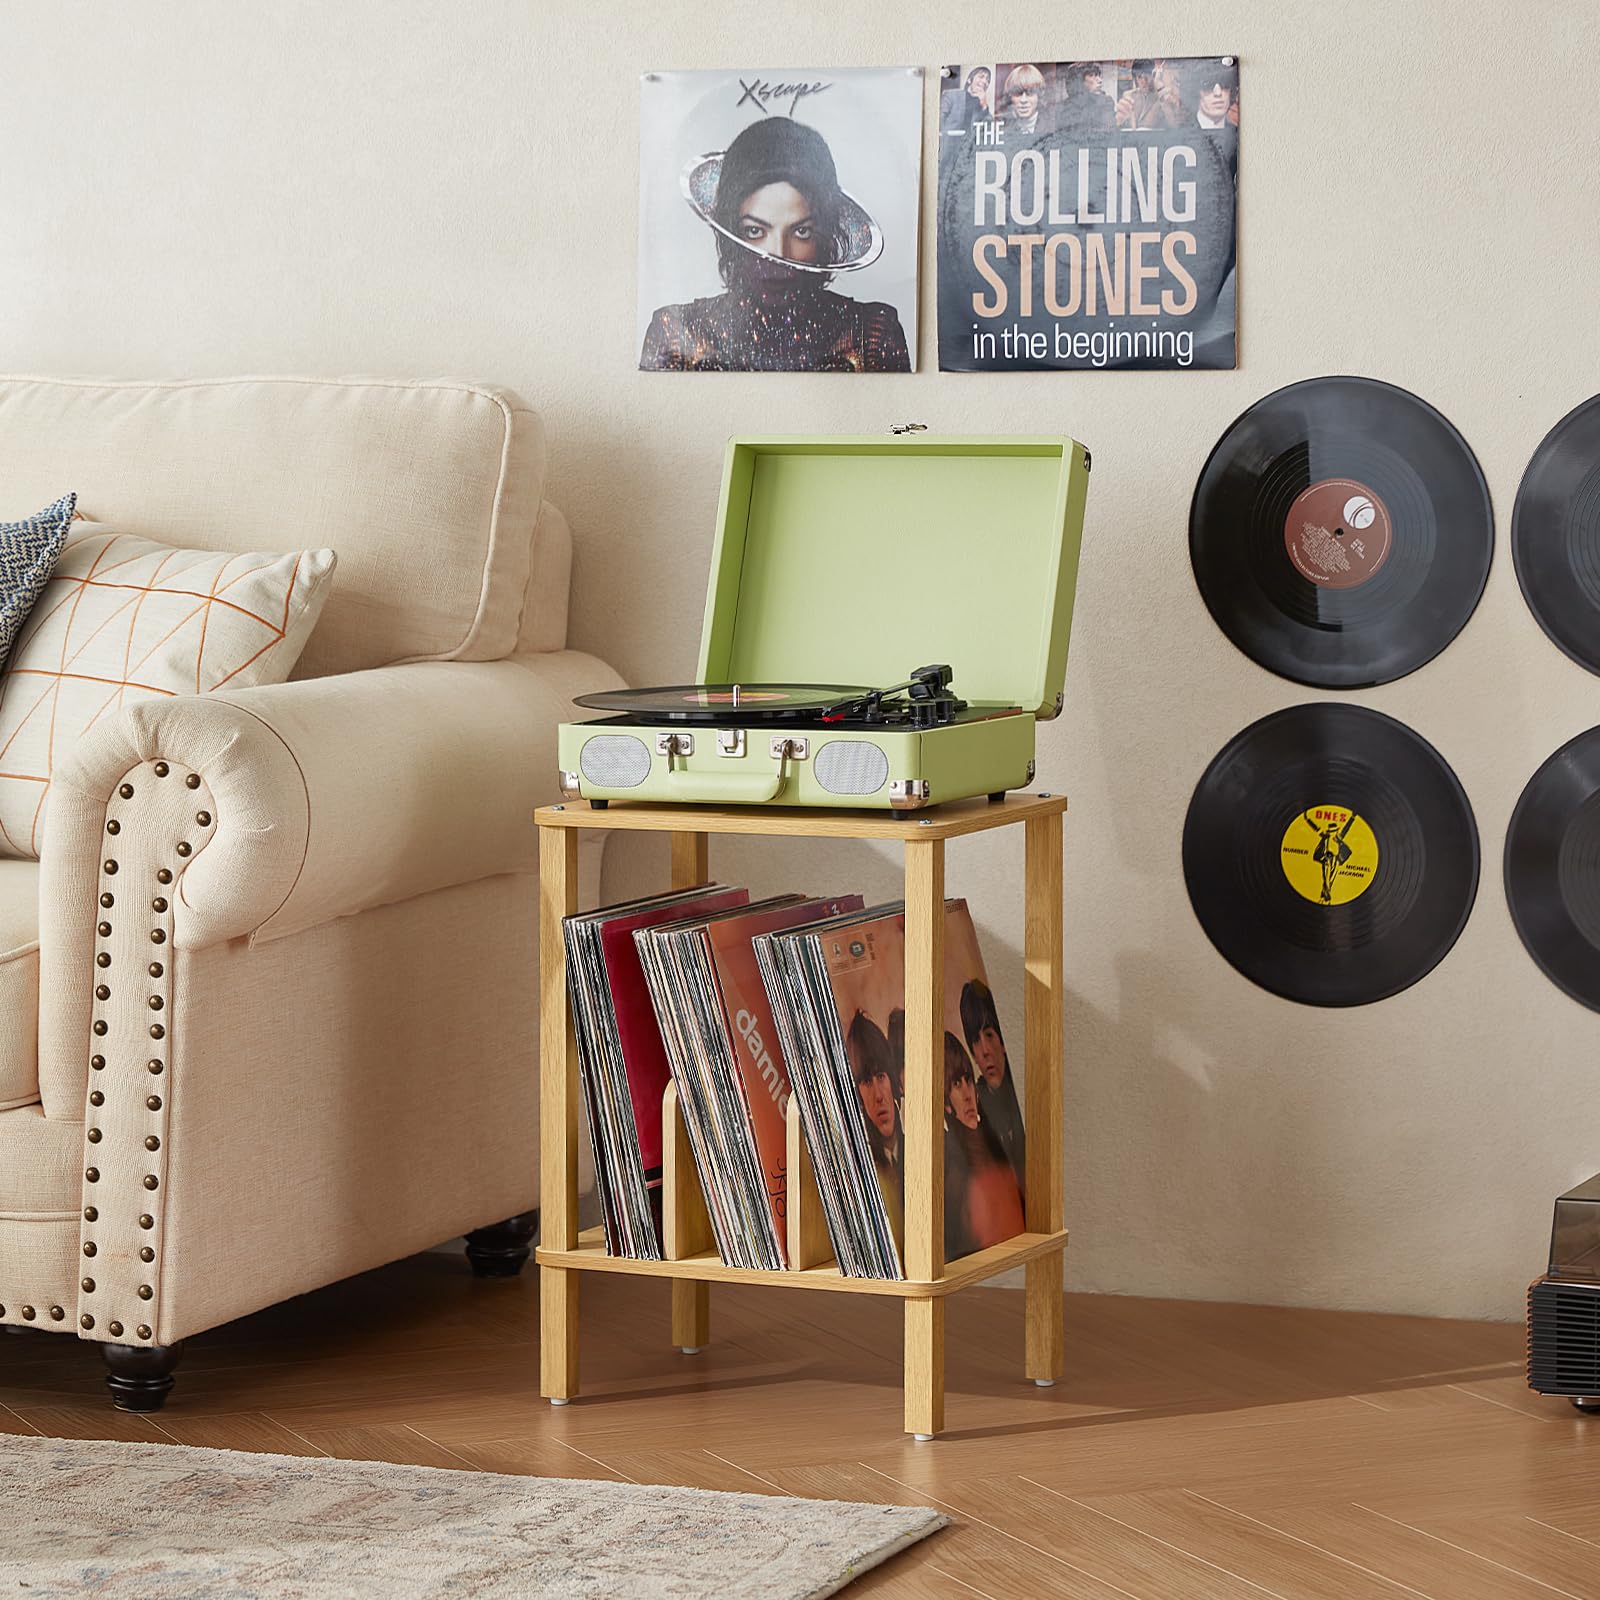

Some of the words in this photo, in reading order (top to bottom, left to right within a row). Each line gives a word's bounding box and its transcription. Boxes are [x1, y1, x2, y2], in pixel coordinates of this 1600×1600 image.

[736, 78, 832, 117] Xscape
[973, 121, 1005, 146] THE
[974, 146, 1197, 226] ROLLING
[972, 231, 1198, 318] STONES
[973, 324, 996, 359] in
[1001, 323, 1047, 359] the
[1055, 322, 1194, 367] beginning
[1315, 810, 1347, 823] ONES
[1283, 847, 1309, 855] NUMBER
